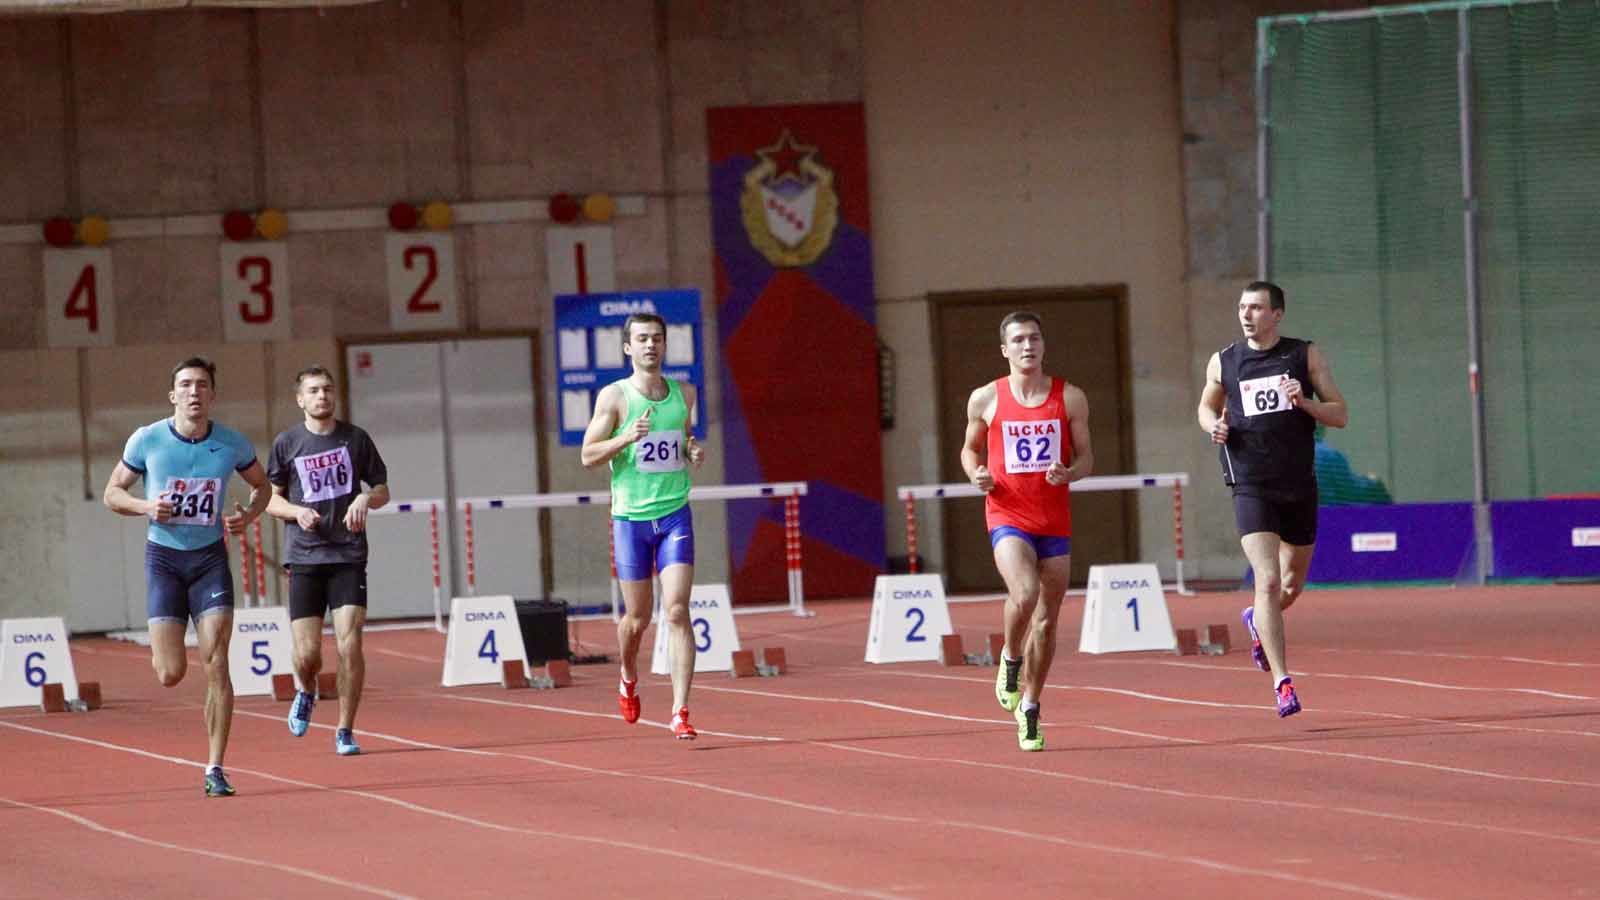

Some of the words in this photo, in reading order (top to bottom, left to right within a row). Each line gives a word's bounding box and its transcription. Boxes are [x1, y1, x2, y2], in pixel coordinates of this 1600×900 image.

[403, 245, 441, 313] 2
[575, 243, 587, 294] 1
[64, 264, 98, 333] 4
[236, 256, 274, 323] 3
[1255, 389, 1279, 411] 69
[1008, 424, 1055, 437] ЦСКА
[643, 440, 679, 462] 261
[1016, 437, 1050, 462] 62
[309, 463, 348, 493] 646
[171, 493, 214, 518] 334
[893, 590, 933, 600] DIMA
[1109, 579, 1150, 590] DIMA
[465, 611, 506, 622] DIMA
[690, 600, 719, 609] IMA
[1126, 598, 1140, 632] 1
[13, 633, 55, 644] DIMA
[239, 622, 280, 633] DIMA
[692, 618, 711, 652] 3
[905, 608, 926, 642] 2
[250, 641, 272, 676] 5
[478, 629, 499, 664] 4
[25, 652, 47, 687] 6
